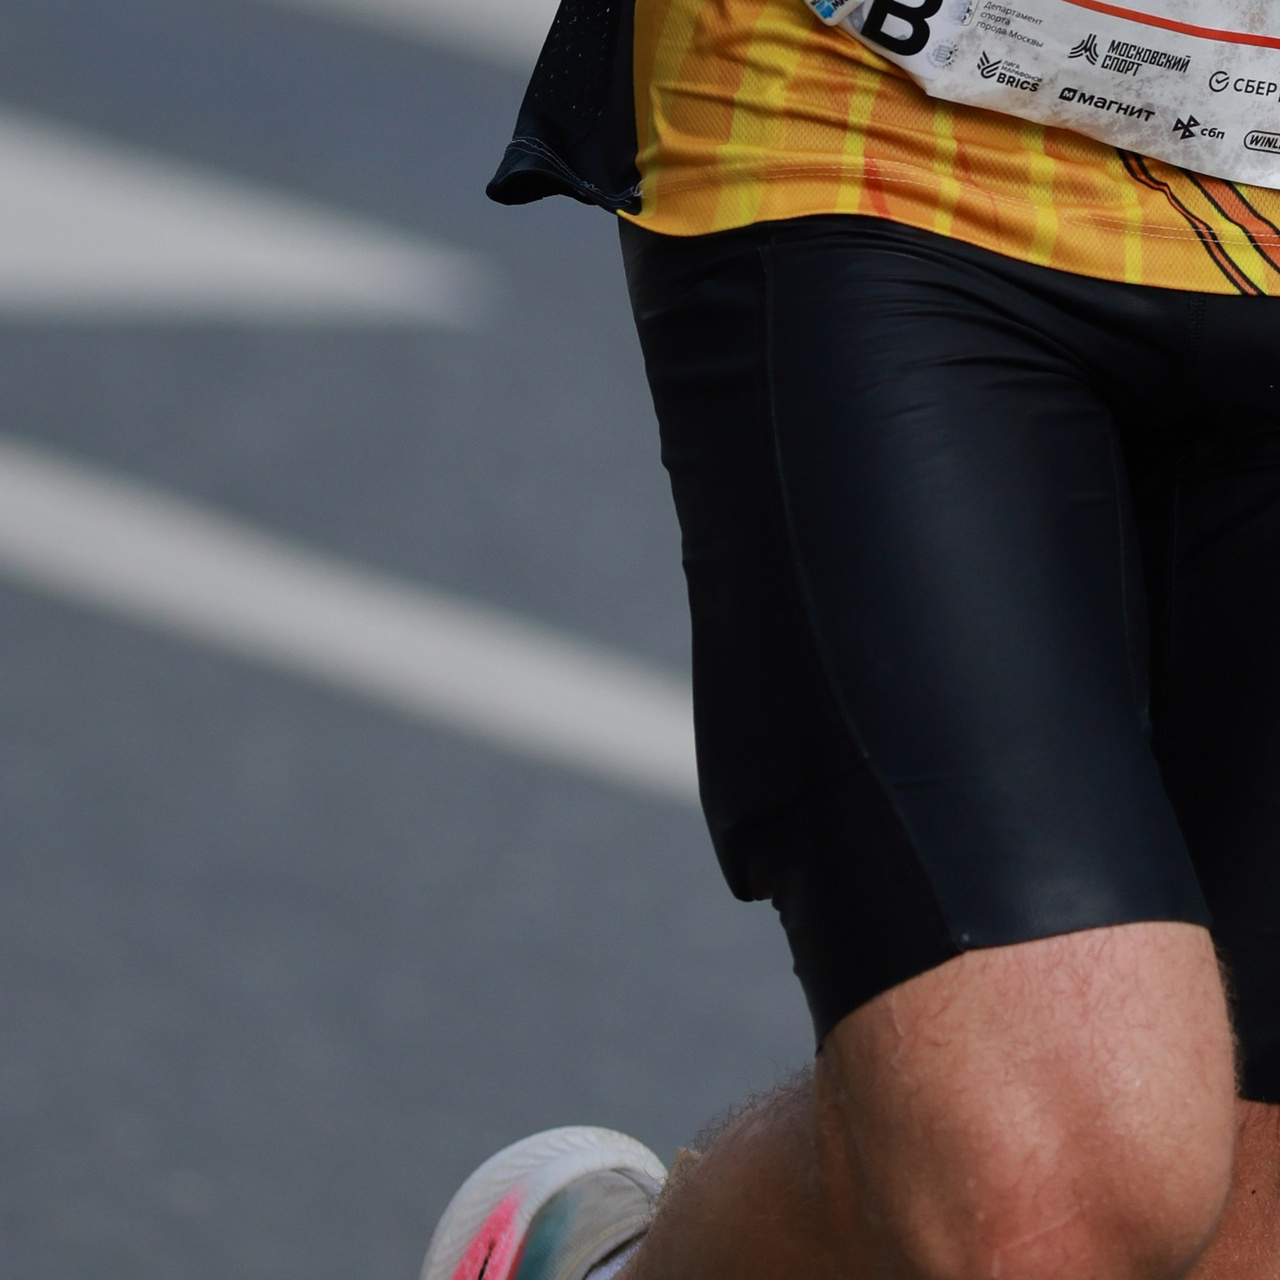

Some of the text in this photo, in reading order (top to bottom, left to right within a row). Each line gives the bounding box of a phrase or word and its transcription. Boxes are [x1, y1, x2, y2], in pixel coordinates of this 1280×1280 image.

[980, 11, 1011, 26] спорта
[983, 1, 1043, 25] Департамент
[976, 21, 1044, 48] города Москвы
[1003, 60, 1020, 69] ЛИГА
[1100, 54, 1143, 77] СПОРТ
[1107, 40, 1192, 73] МОСКОВСКИЙ
[996, 72, 1040, 93] BRICS
[1233, 78, 1278, 97] СБЕР
[1200, 127, 1225, 140] сбп
